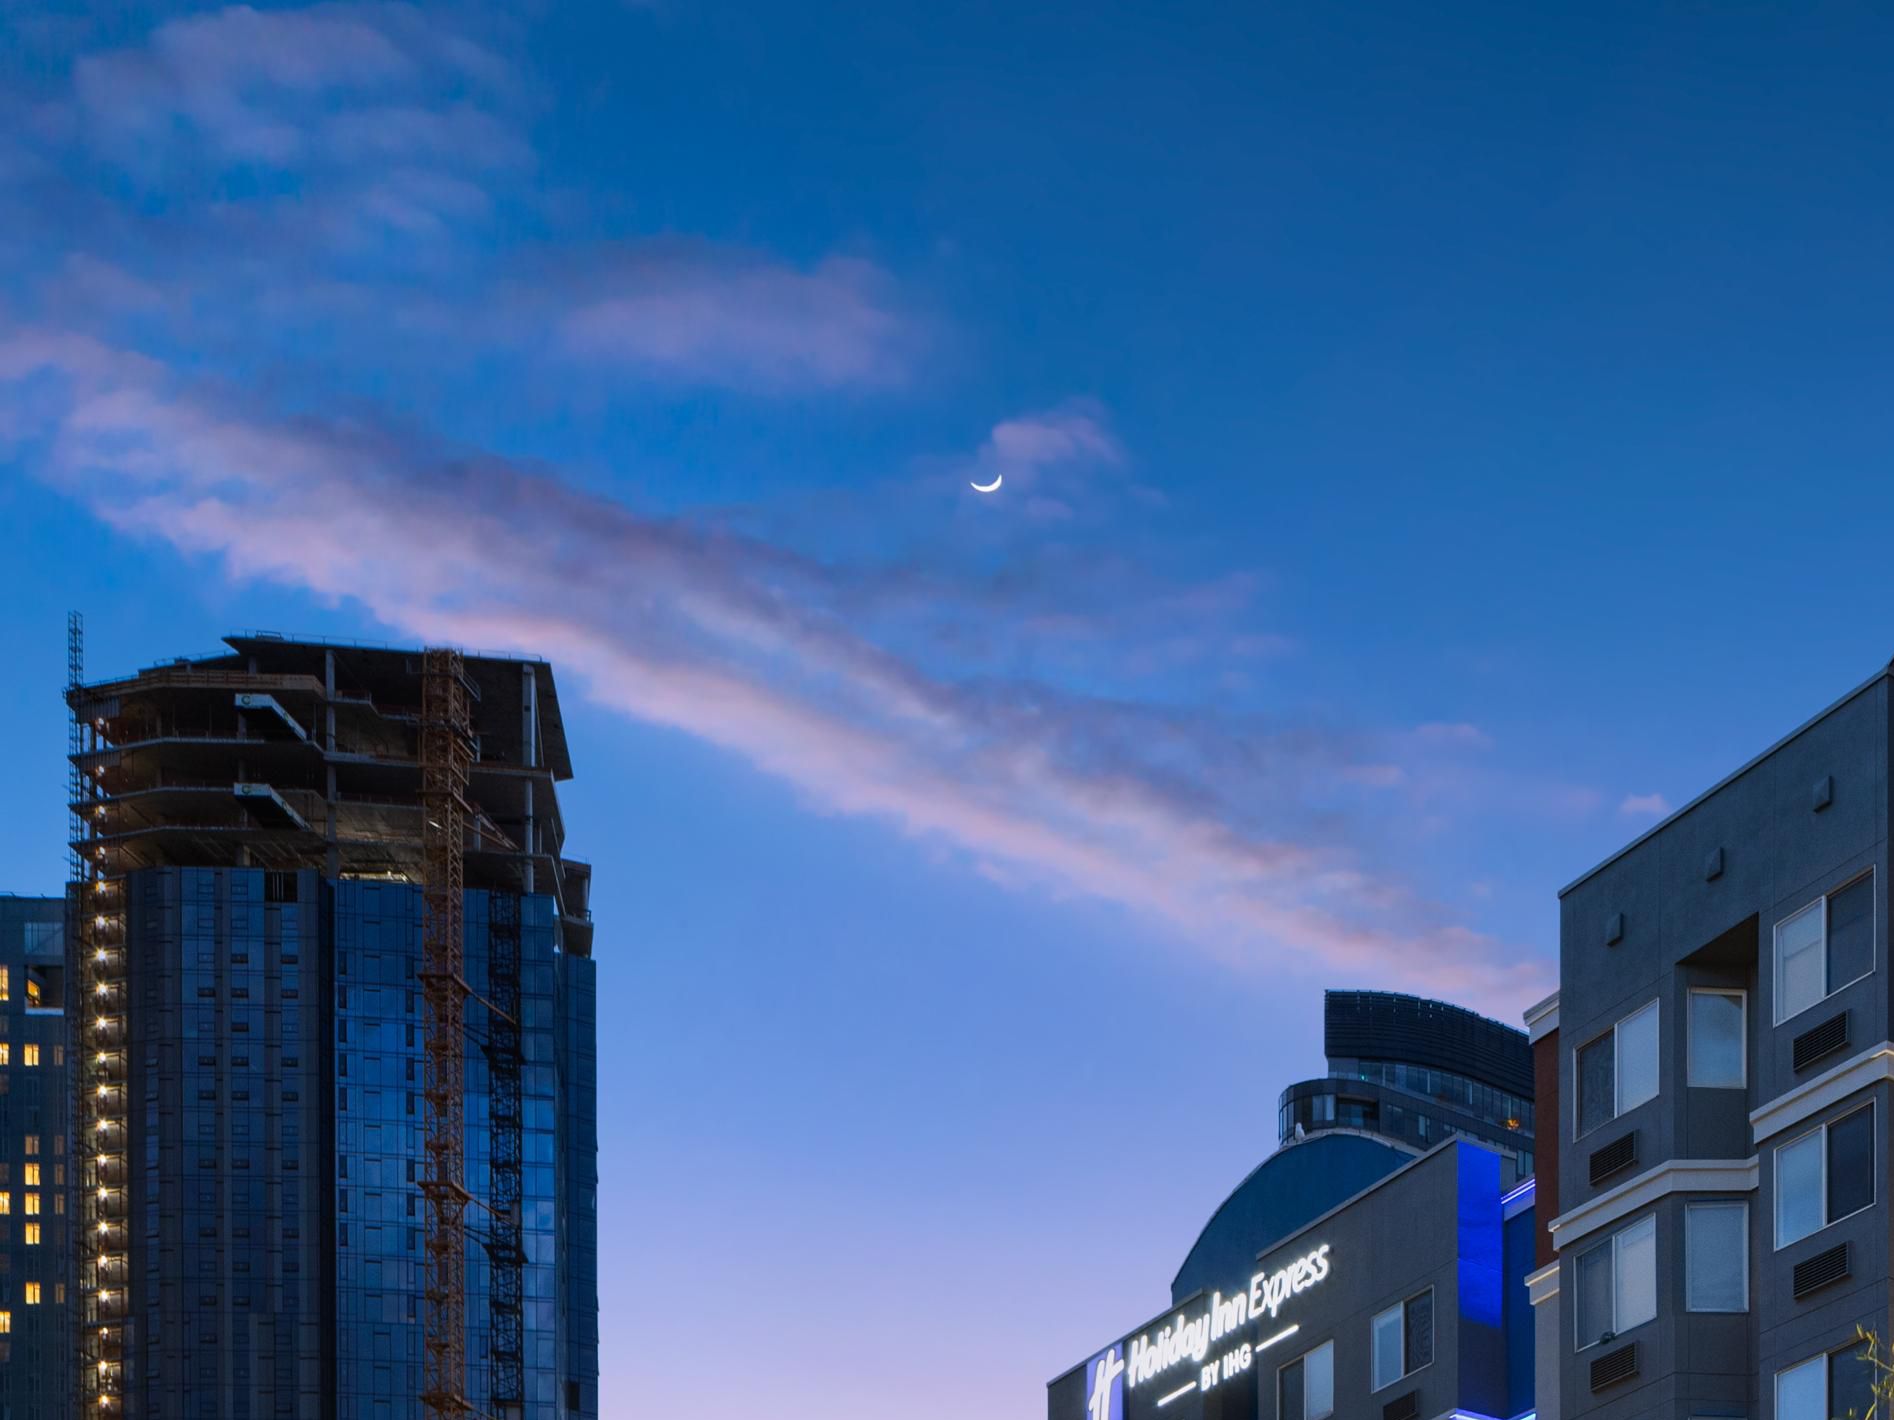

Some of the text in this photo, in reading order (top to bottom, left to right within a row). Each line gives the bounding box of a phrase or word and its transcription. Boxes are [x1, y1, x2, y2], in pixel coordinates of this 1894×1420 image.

[1127, 1244, 1330, 1388] Holiday Inn Express
[1200, 1342, 1252, 1391] BY IHG
